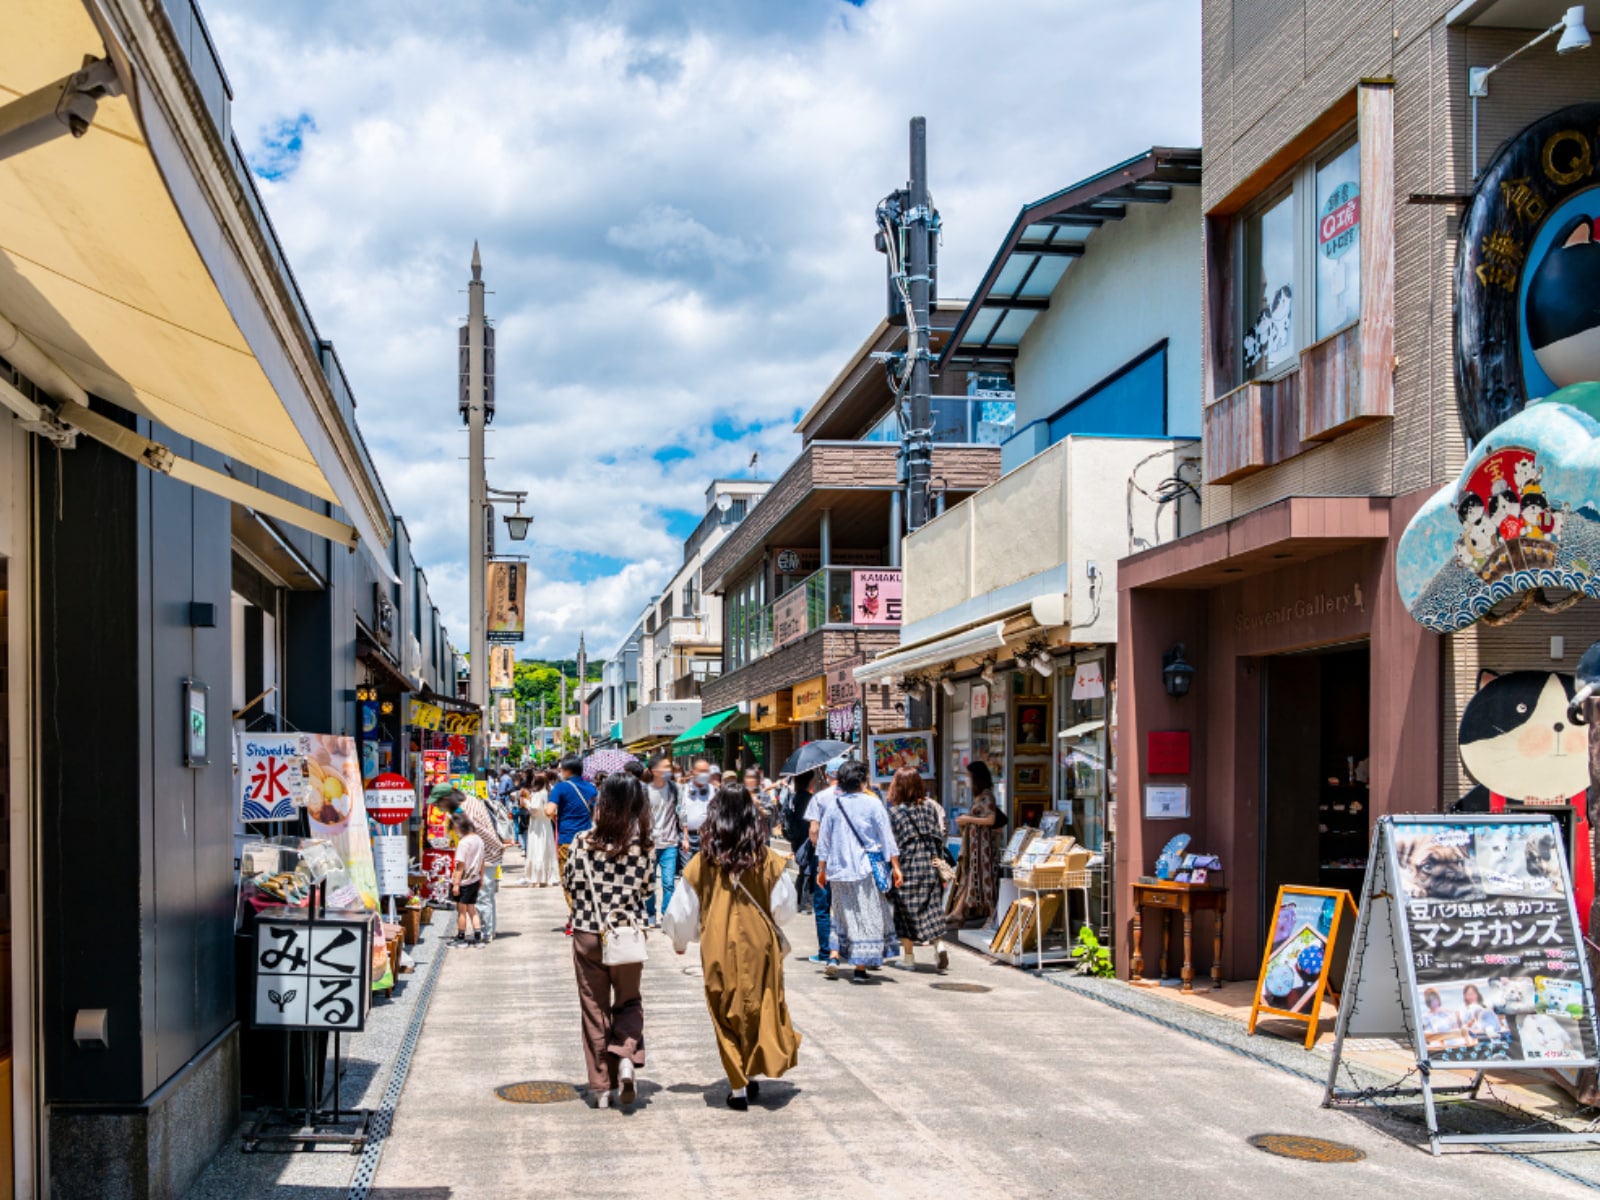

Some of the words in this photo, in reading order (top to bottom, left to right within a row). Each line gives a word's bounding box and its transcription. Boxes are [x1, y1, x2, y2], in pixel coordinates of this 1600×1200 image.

[1295, 593, 1351, 619] Gallery
[246, 742, 281, 756] Shaved
[250, 755, 291, 803] 氷
[1413, 915, 1564, 948] マンチカンズ
